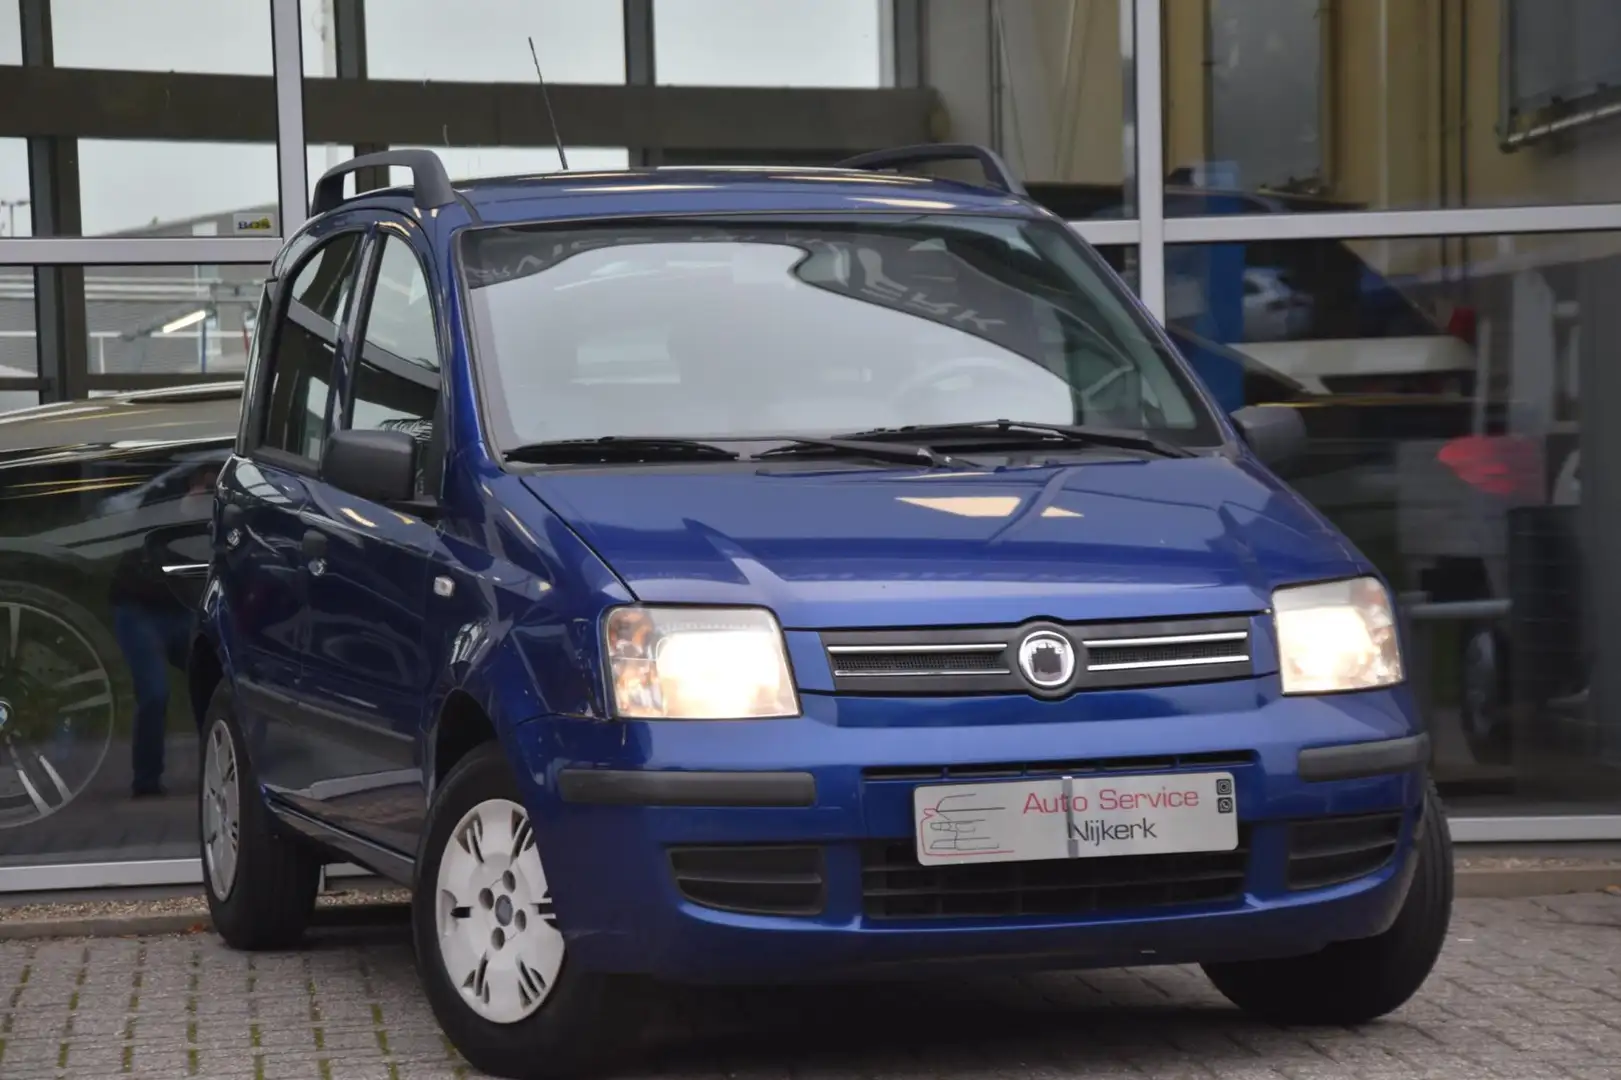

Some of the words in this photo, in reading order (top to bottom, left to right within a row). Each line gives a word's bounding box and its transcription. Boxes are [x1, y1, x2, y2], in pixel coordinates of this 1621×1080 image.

[1022, 791, 1088, 814] Auto
[1099, 786, 1199, 810] Service
[1068, 817, 1157, 846] Nijkerk
